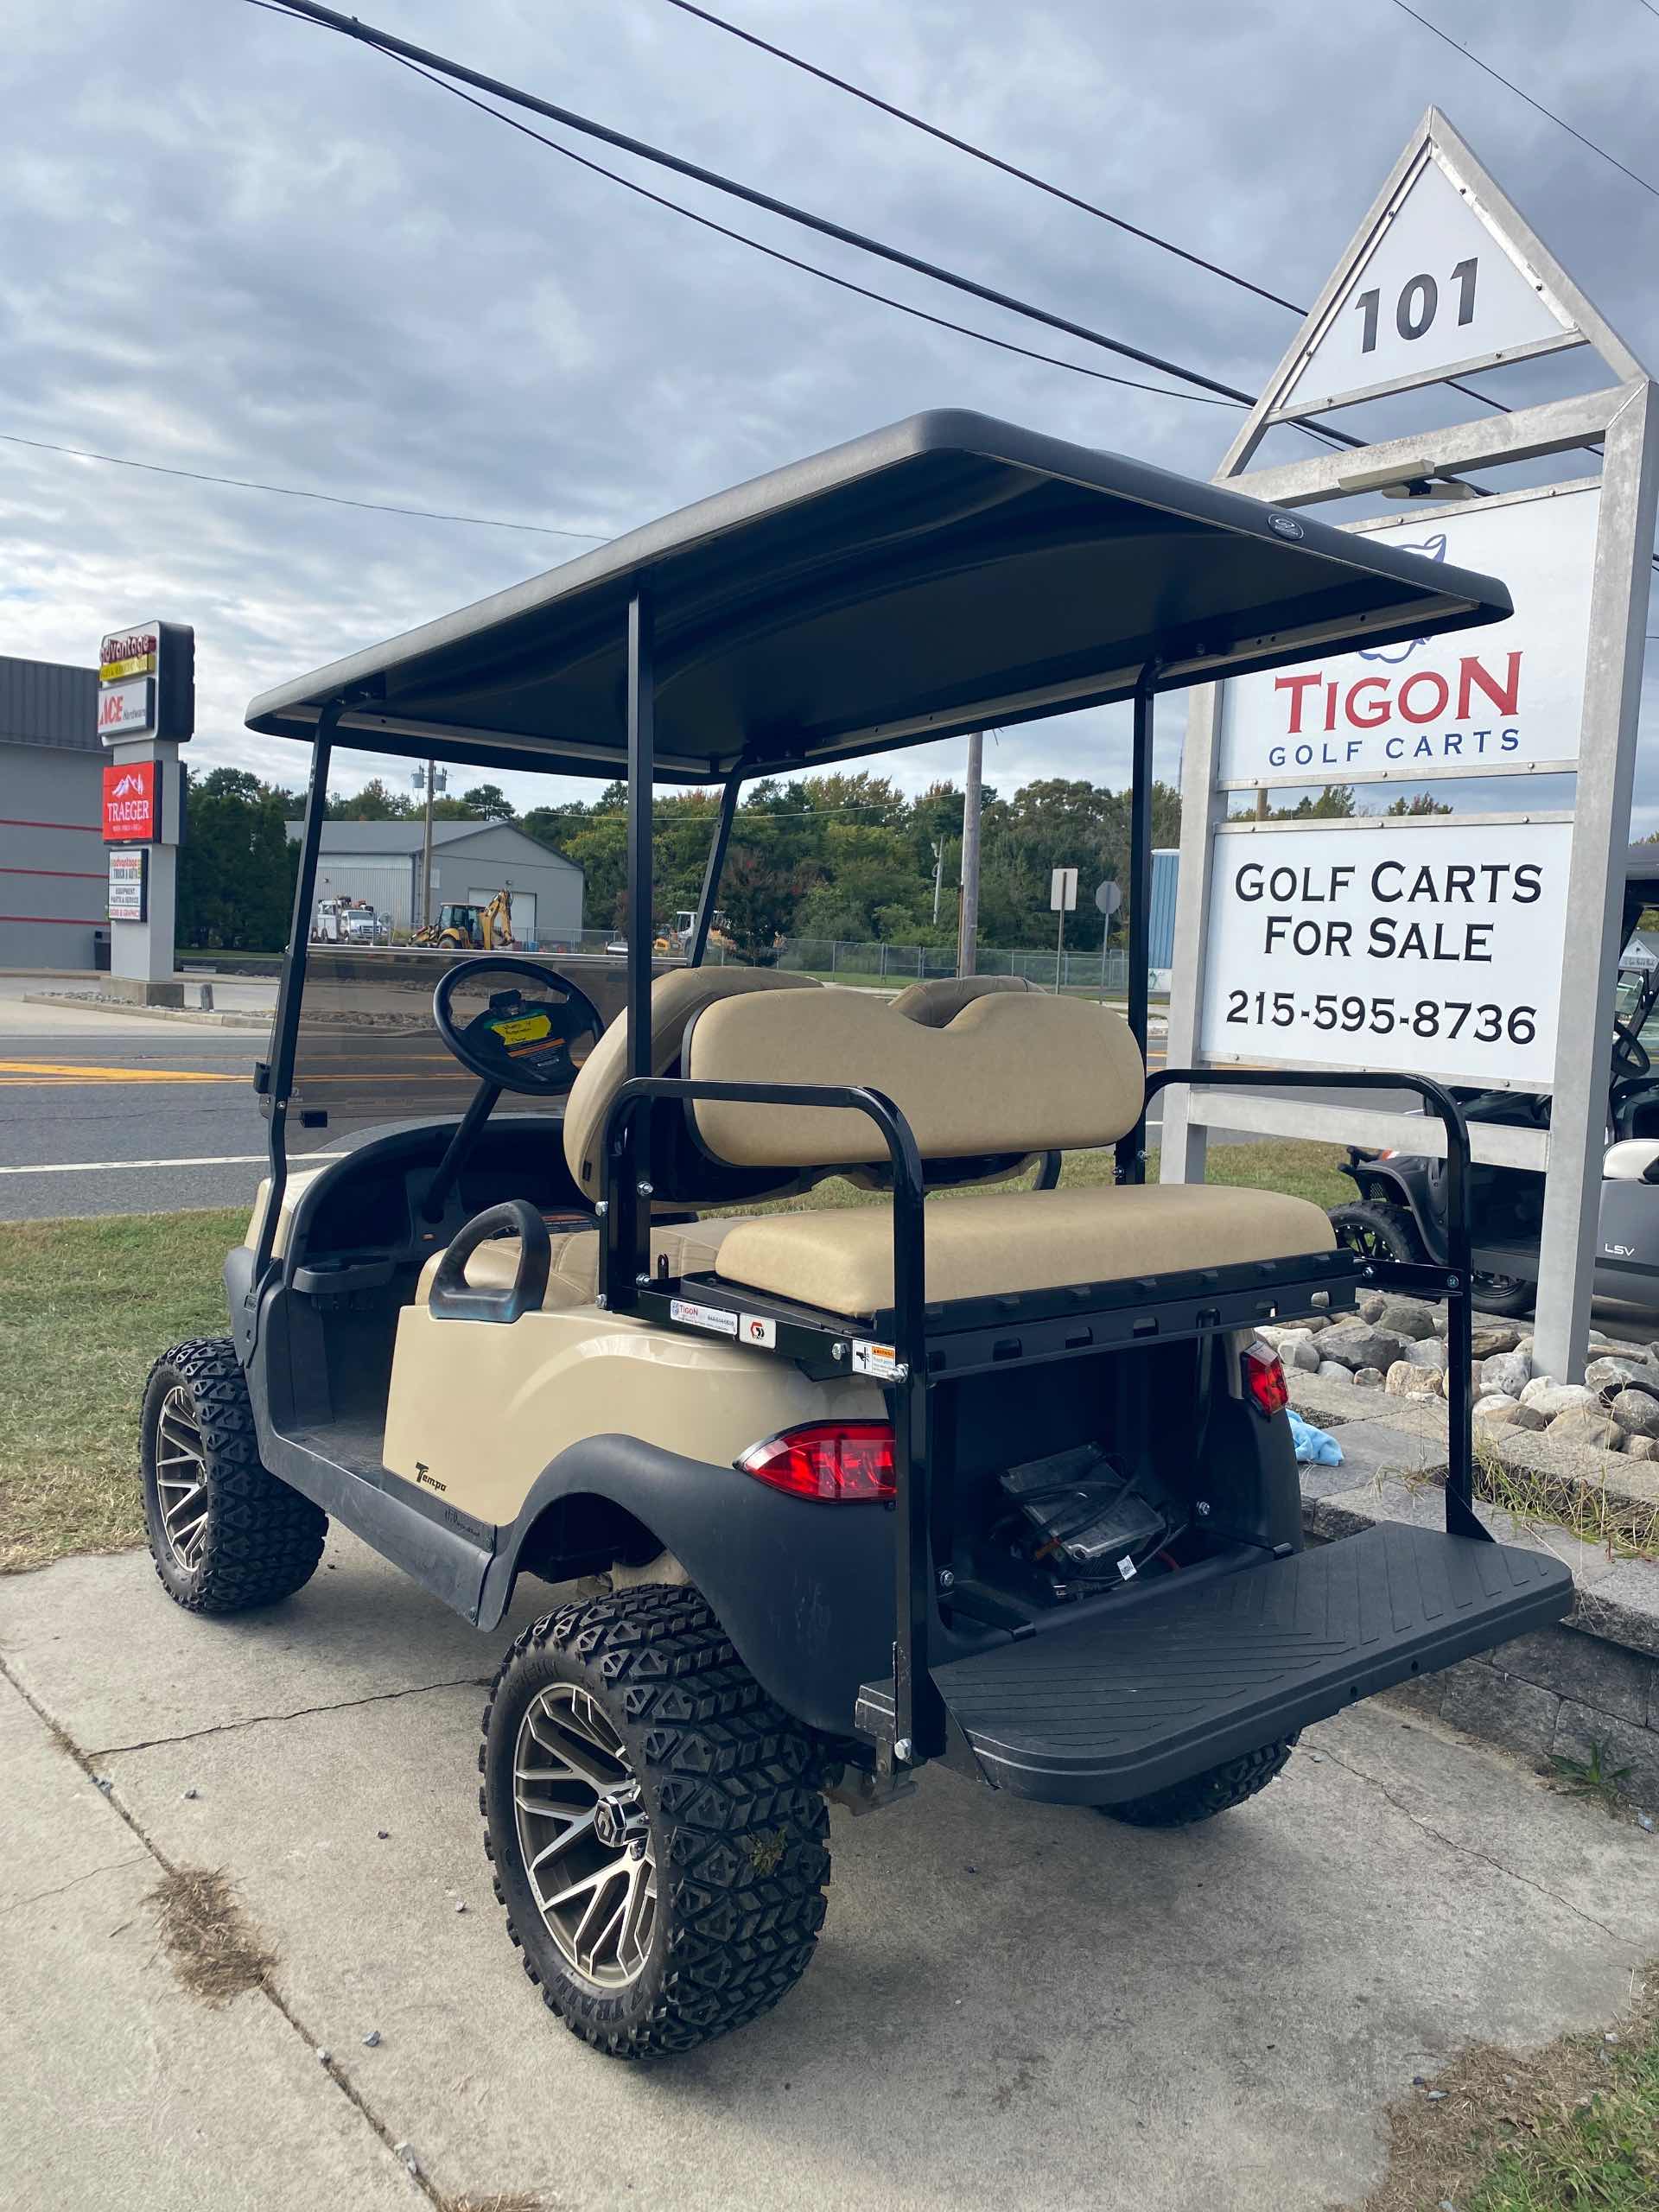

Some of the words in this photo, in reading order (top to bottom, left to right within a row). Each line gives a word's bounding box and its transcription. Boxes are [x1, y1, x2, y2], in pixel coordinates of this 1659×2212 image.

[1354, 257, 1478, 354] 101
[99, 696, 124, 725] ACE
[1274, 651, 1523, 734] TIGON
[1268, 741, 1363, 766] GOLF
[1385, 728, 1520, 759] CARTS
[107, 800, 149, 822] TRAEGER
[1236, 862, 1356, 902] GOLF
[1371, 861, 1543, 904] CARTS
[1264, 914, 1352, 957] FOR
[1367, 917, 1495, 963] SALE
[1226, 989, 1538, 1045] 215-595-8736
[1605, 1243, 1635, 1256] LSV
[680, 1300, 699, 1316] TIGON
[415, 1461, 448, 1491] Tempo
